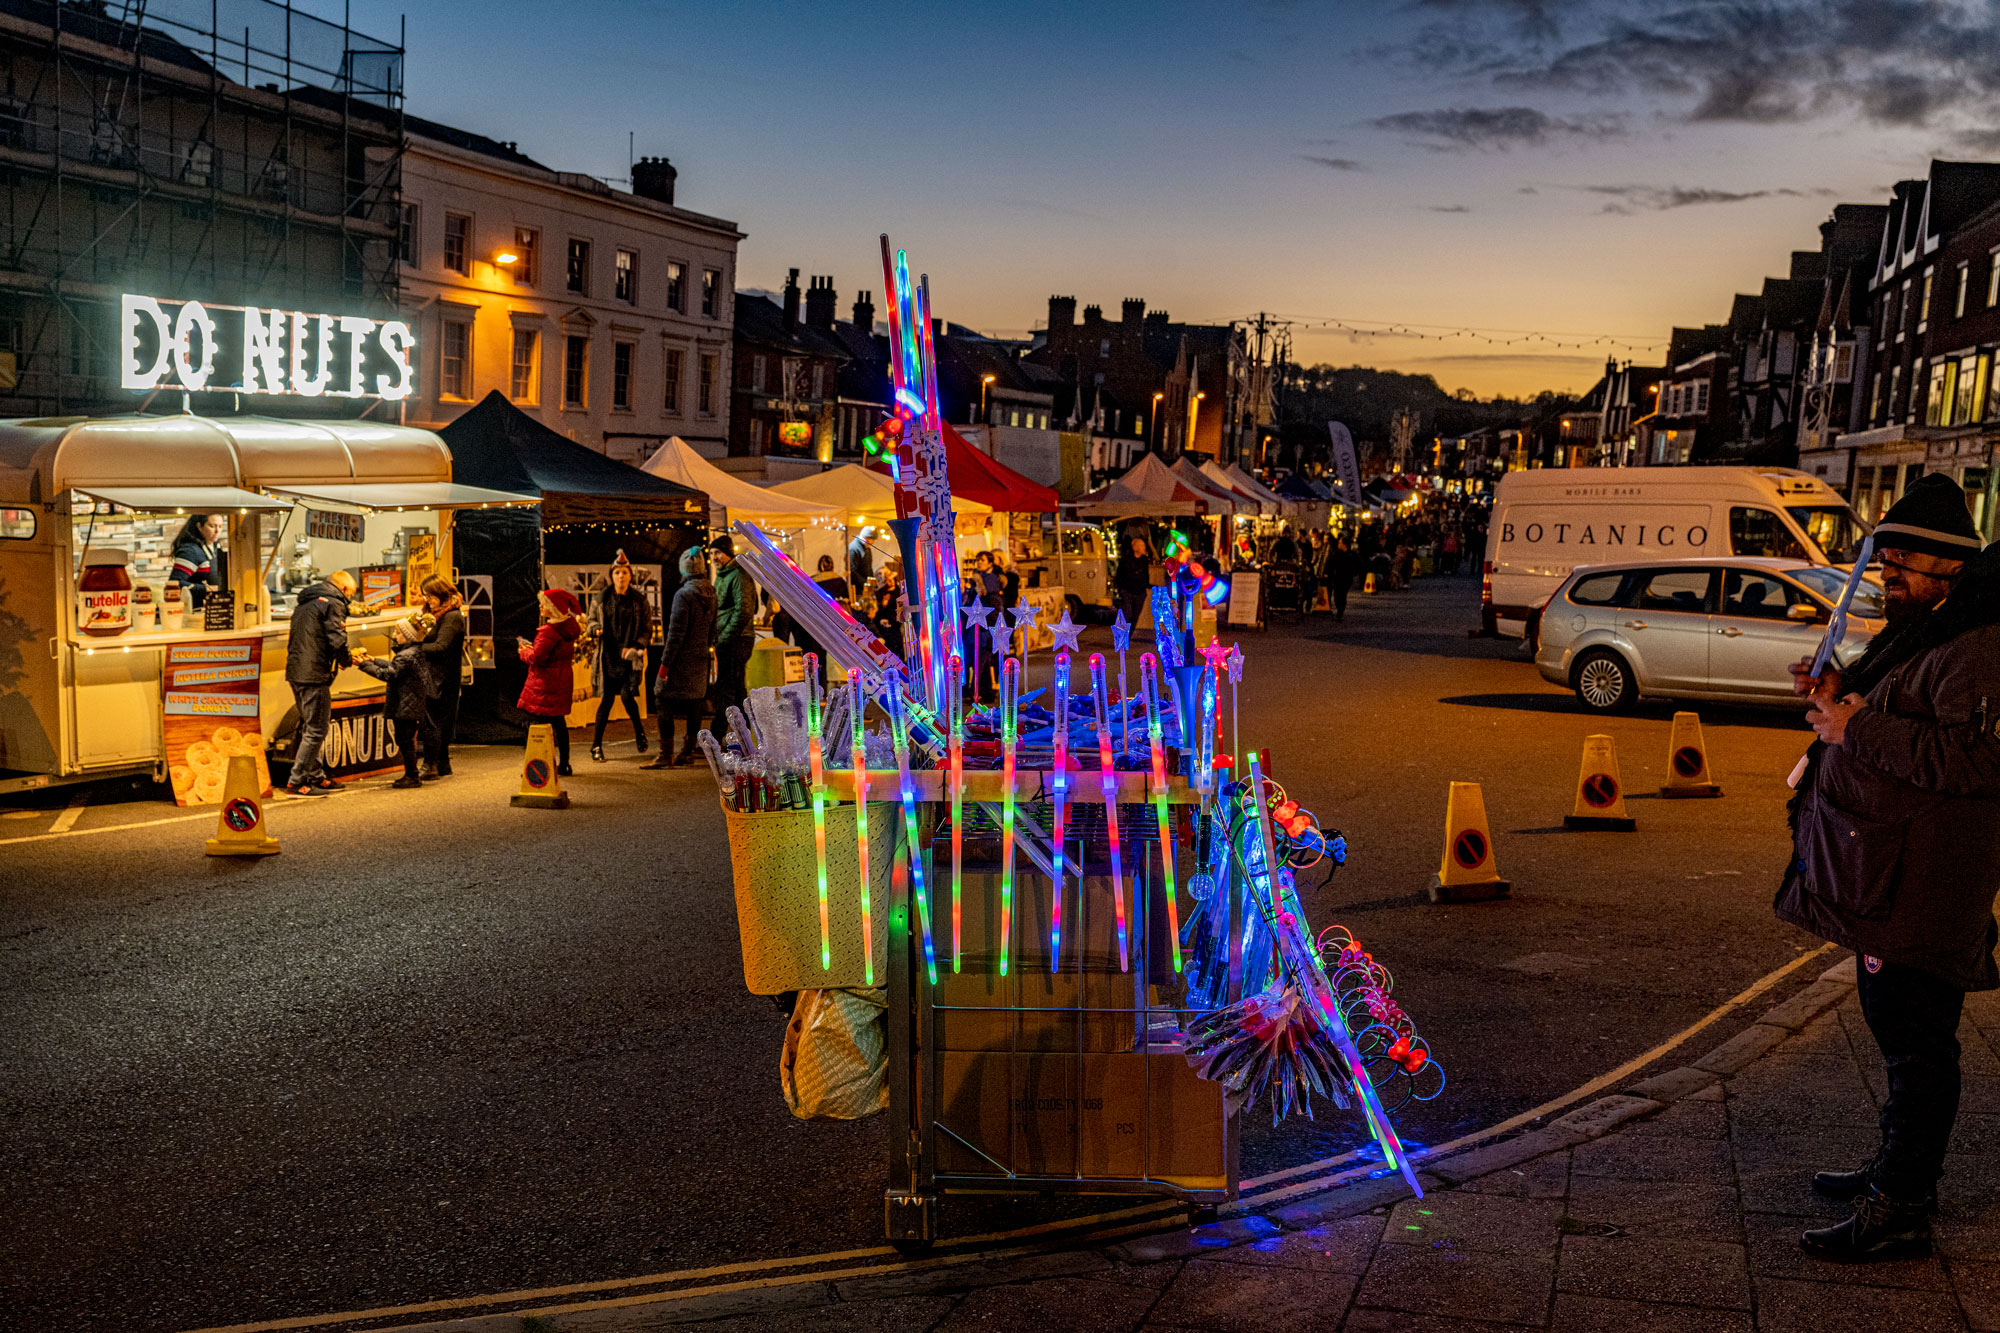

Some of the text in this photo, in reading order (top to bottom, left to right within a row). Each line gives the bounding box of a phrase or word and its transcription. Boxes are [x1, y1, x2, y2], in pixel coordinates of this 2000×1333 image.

[310, 522, 359, 542] DONUTS
[1501, 523, 1708, 546] BOTANICO
[85, 592, 128, 608] nutella
[173, 650, 247, 659] SUGAR DONUTS
[175, 668, 257, 682] NUTELLA DONUTS
[168, 695, 257, 706] WHITE CHOCOLATE
[192, 703, 231, 713] DONUTS
[1116, 1123, 1134, 1134] PCS
